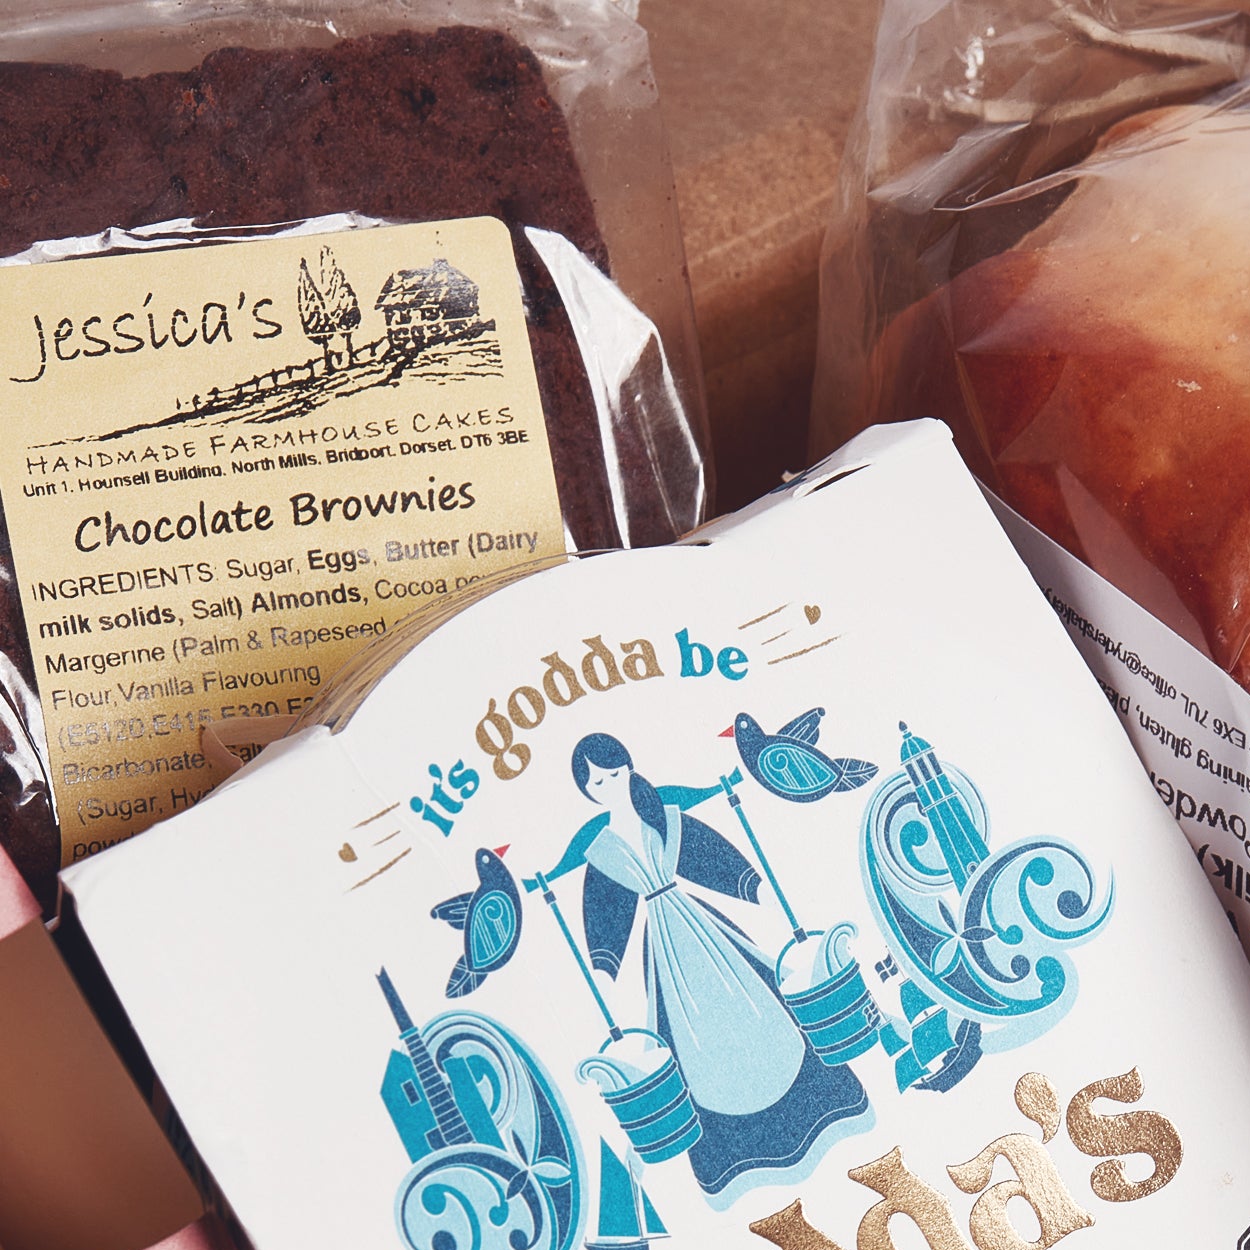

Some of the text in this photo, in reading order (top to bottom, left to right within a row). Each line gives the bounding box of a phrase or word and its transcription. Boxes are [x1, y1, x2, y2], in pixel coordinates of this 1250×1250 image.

[9, 291, 283, 383] Jessica's
[22, 482, 57, 498] Unit
[78, 471, 150, 492] Hounsell
[231, 454, 276, 474] North
[460, 433, 492, 449] DT6
[496, 429, 530, 445] 3BE
[26, 406, 515, 475] HANDMADE FARMHOUSE CAKES
[74, 475, 477, 552] Chocolate Brownies
[31, 530, 538, 602] INGREDIENTS: Sugar, Eggs, Butter (Dairy
[38, 614, 93, 639] milk
[99, 604, 184, 632] solids,
[191, 595, 243, 621] Salt)
[251, 583, 368, 614] Almonds,
[374, 577, 448, 600] Cocoa
[45, 616, 387, 675] Margerine (Palm & Rapeseed
[201, 664, 321, 692] Flavouring
[409, 627, 750, 838] it's godda be
[1135, 703, 1193, 759] gluten,
[1180, 692, 1210, 729] 7UL
[1212, 718, 1247, 750] EX6
[77, 794, 164, 826] (Sugar,
